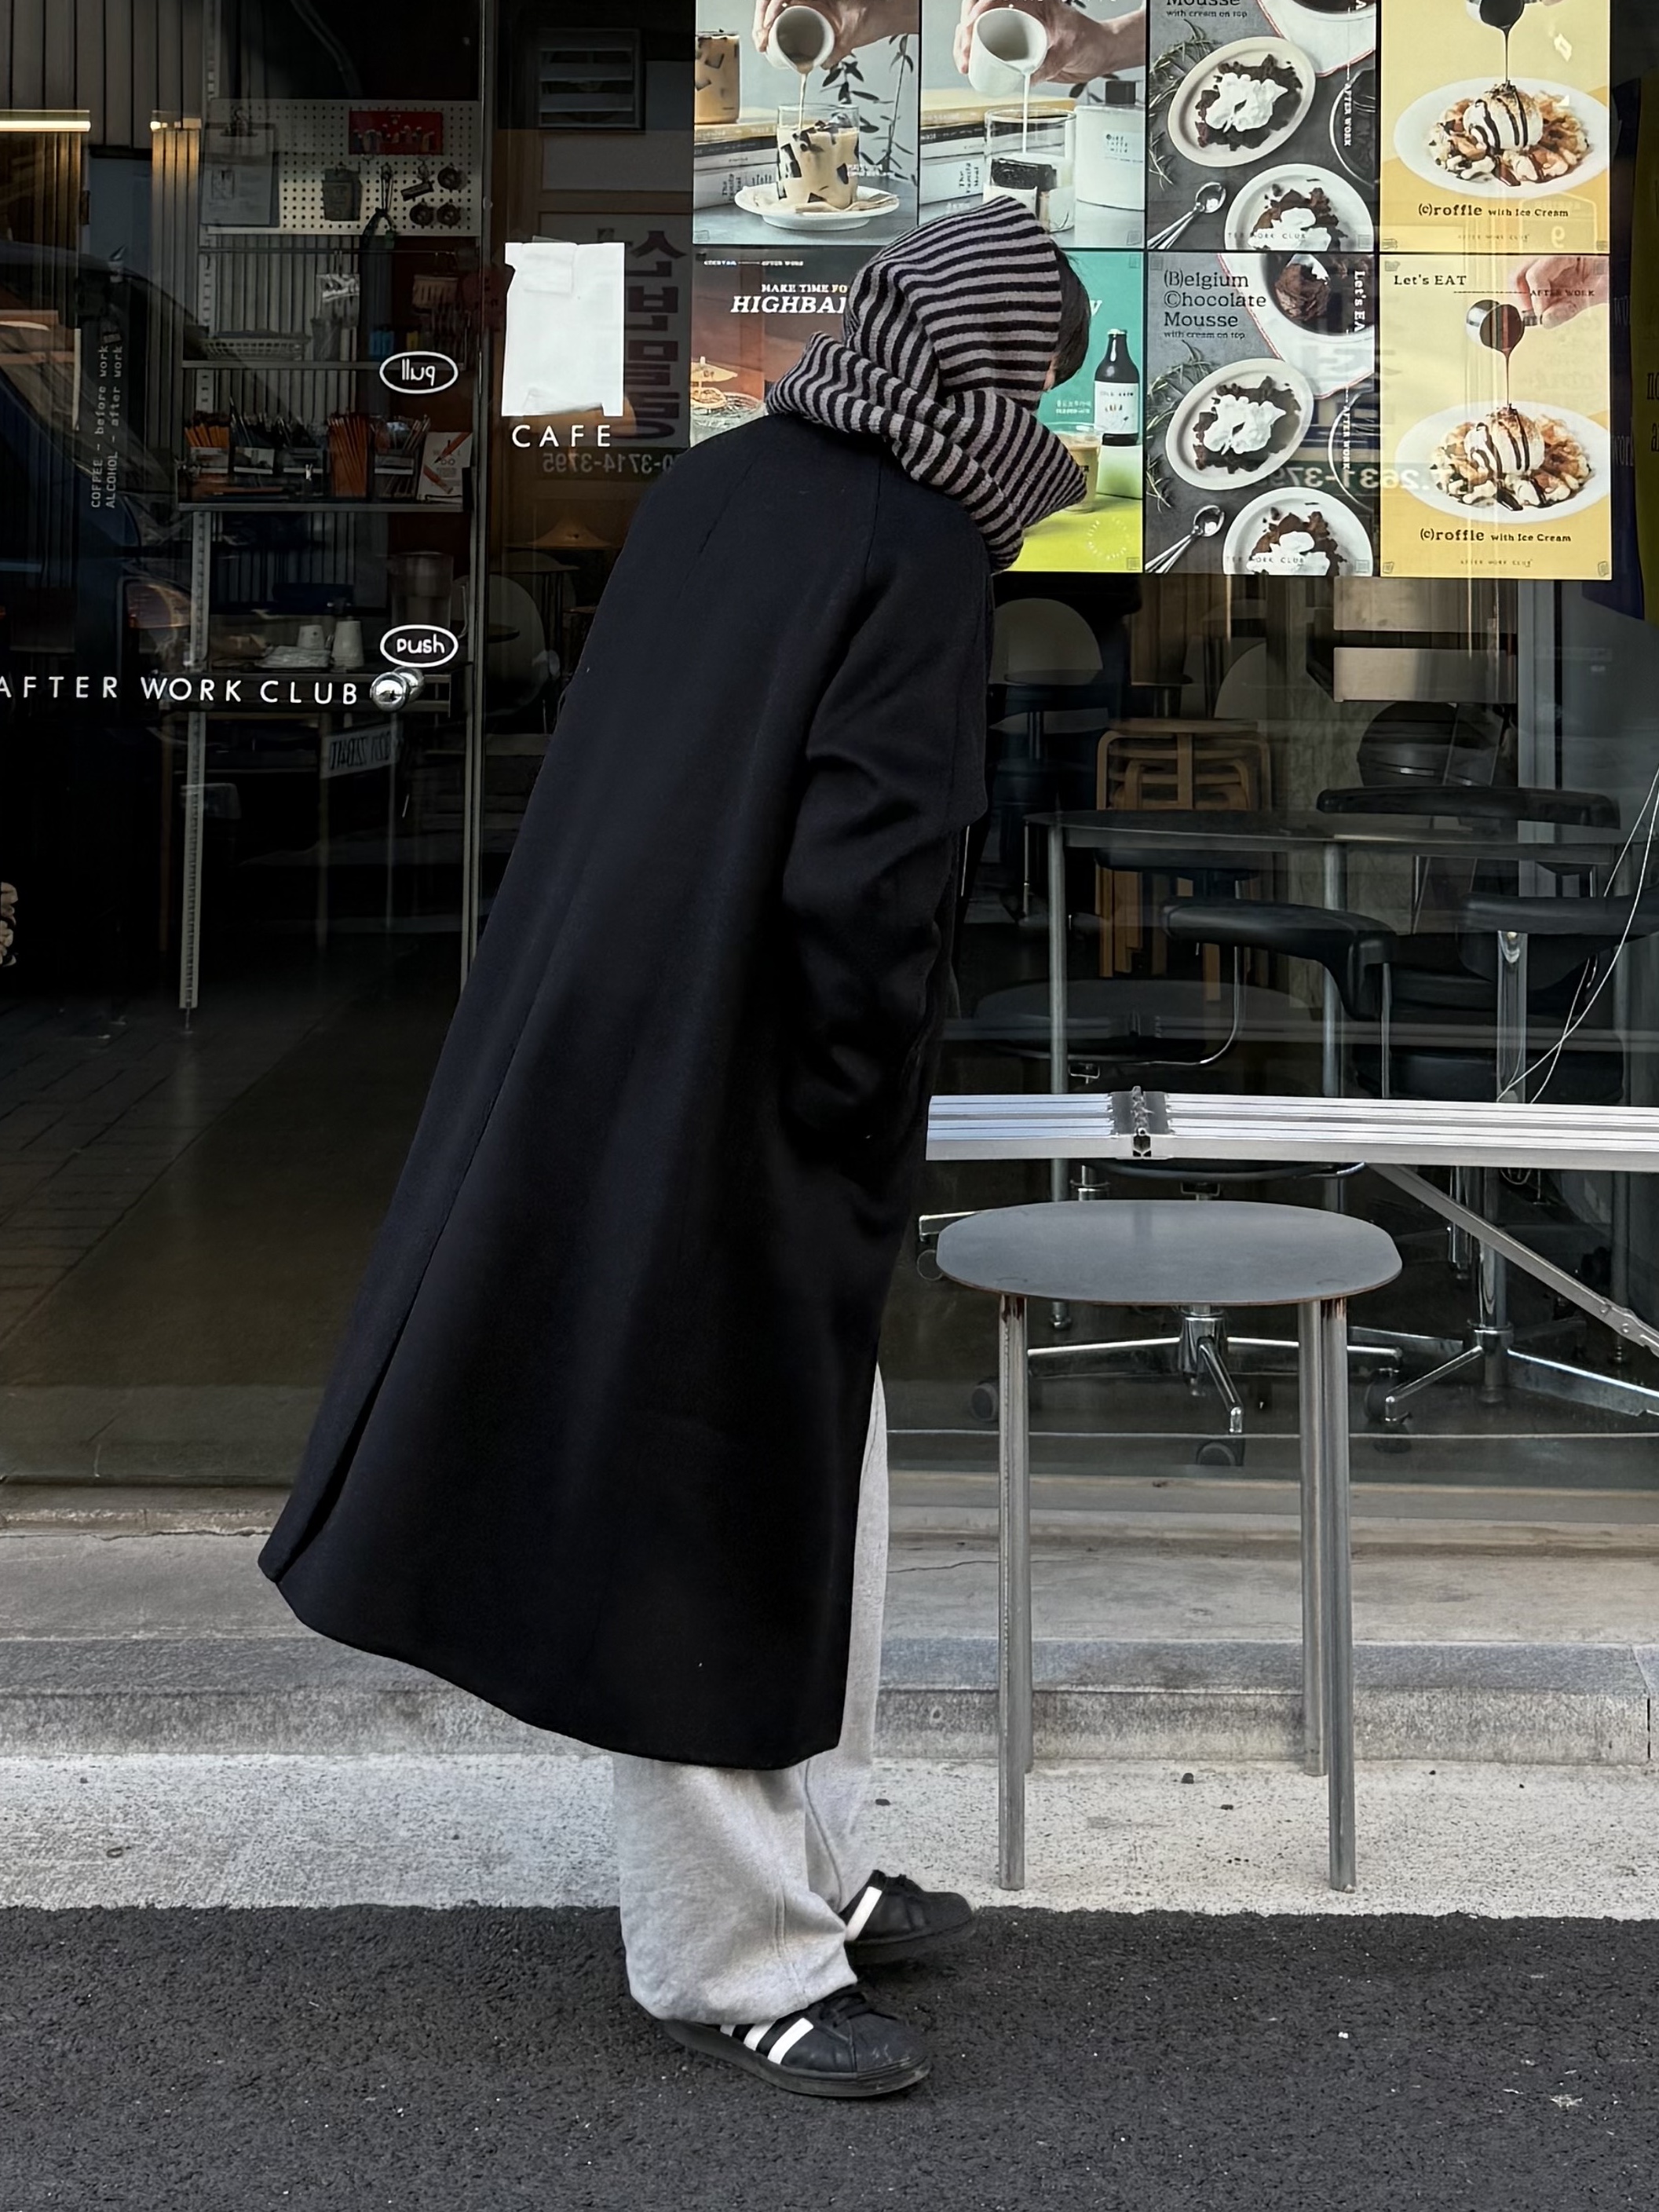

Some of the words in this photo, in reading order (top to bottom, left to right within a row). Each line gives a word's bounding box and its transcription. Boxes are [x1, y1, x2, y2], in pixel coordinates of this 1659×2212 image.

[1343, 120, 1352, 147] WORK
[1418, 203, 1483, 218] (c)roffle
[1534, 209, 1569, 218] Cream
[761, 283, 796, 293] MAKE
[798, 283, 829, 293] TIME
[1164, 268, 1248, 290] (B)elgium
[1354, 269, 1366, 307] Let's
[1394, 274, 1430, 286] Let's
[1434, 275, 1467, 285] EAT
[1164, 311, 1239, 327] Mousse
[1164, 330, 1184, 338] with
[1230, 331, 1246, 340] top
[98, 345, 108, 378] work
[114, 346, 123, 378] work
[94, 386, 106, 435] before
[110, 386, 120, 427] after
[511, 424, 612, 448] CAFE
[91, 459, 103, 508] COFFEE
[105, 451, 118, 509] ALCOHOL
[1420, 528, 1485, 542] (c)roffle
[1490, 533, 1515, 542] with
[1518, 533, 1533, 542] Ice
[1537, 533, 1572, 542] Cream
[0, 675, 119, 699] AFTER
[140, 676, 243, 703] WORK
[260, 679, 358, 705] CLUB
